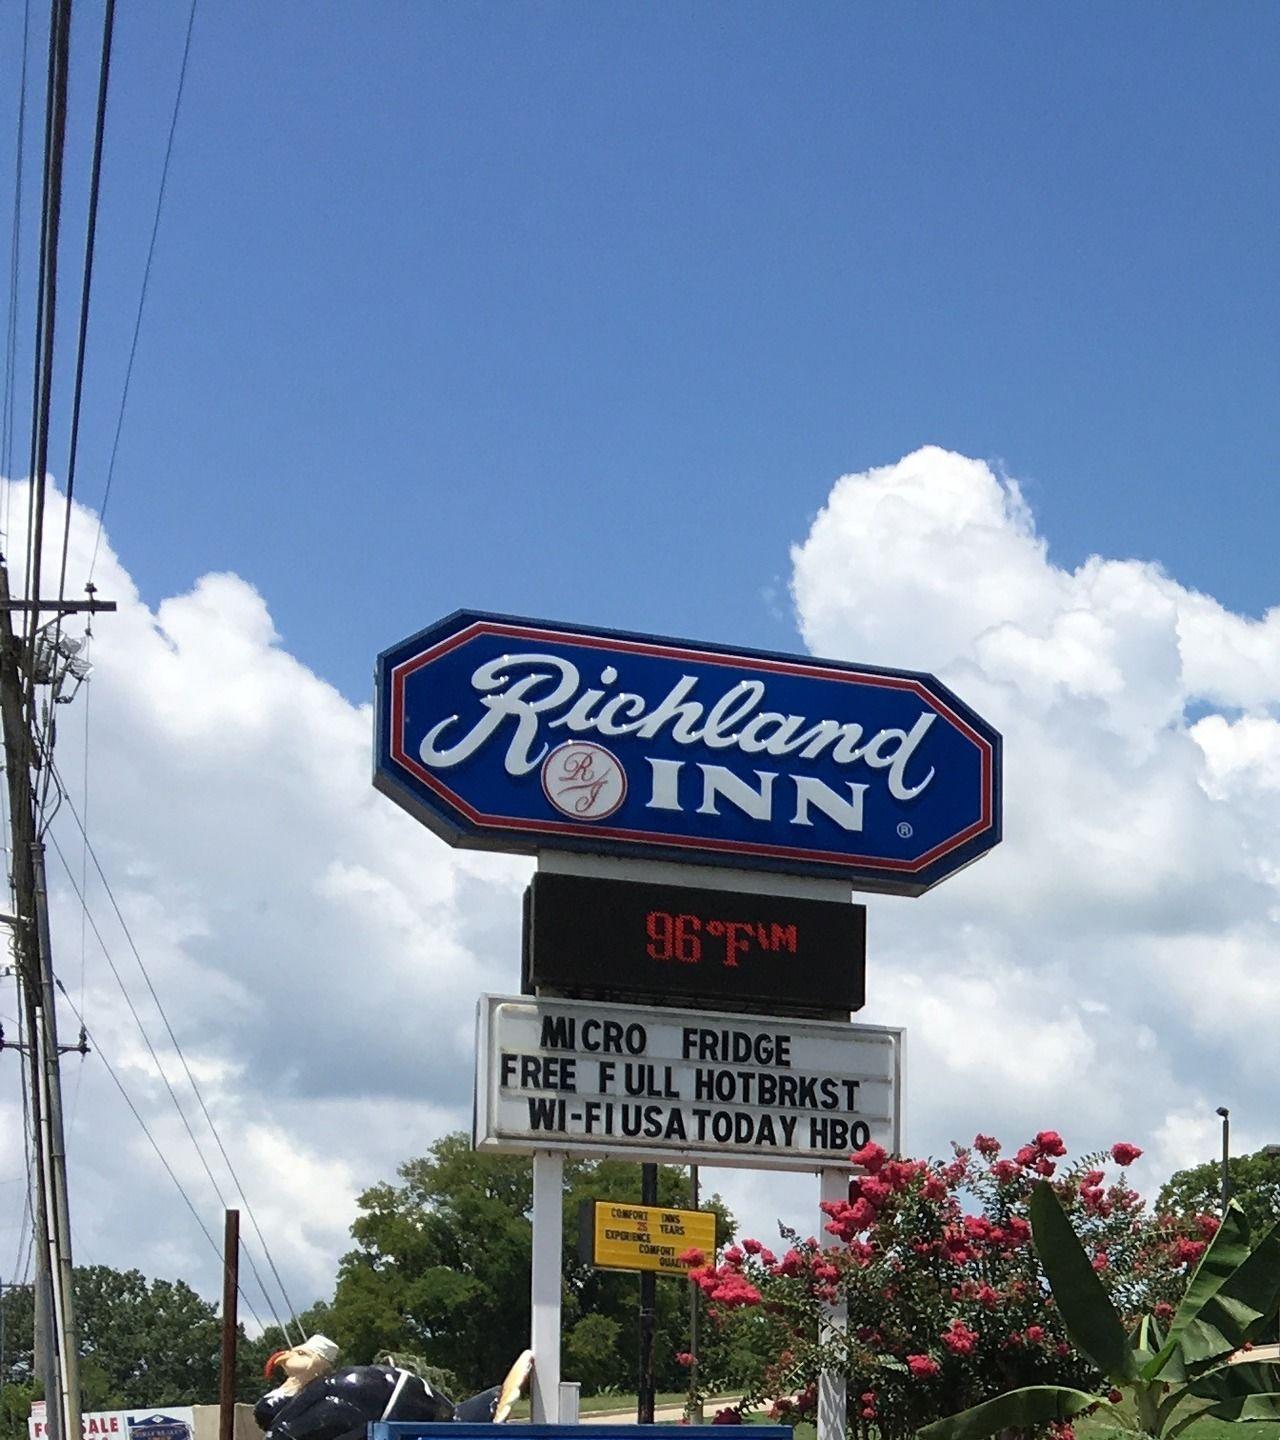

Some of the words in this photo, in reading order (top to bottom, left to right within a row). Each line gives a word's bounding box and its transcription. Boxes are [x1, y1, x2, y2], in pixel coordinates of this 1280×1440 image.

[419, 653, 935, 800] Richland
[644, 756, 871, 832] INN
[540, 1014, 647, 1055] MICRO
[682, 1026, 792, 1067] FRIDGE
[501, 1053, 577, 1092] FREE
[599, 1061, 680, 1098] FULL
[528, 1097, 613, 1134] WI-FI
[621, 1103, 687, 1140] USA
[692, 1108, 797, 1147] TODAY
[810, 1116, 871, 1151] HBO
